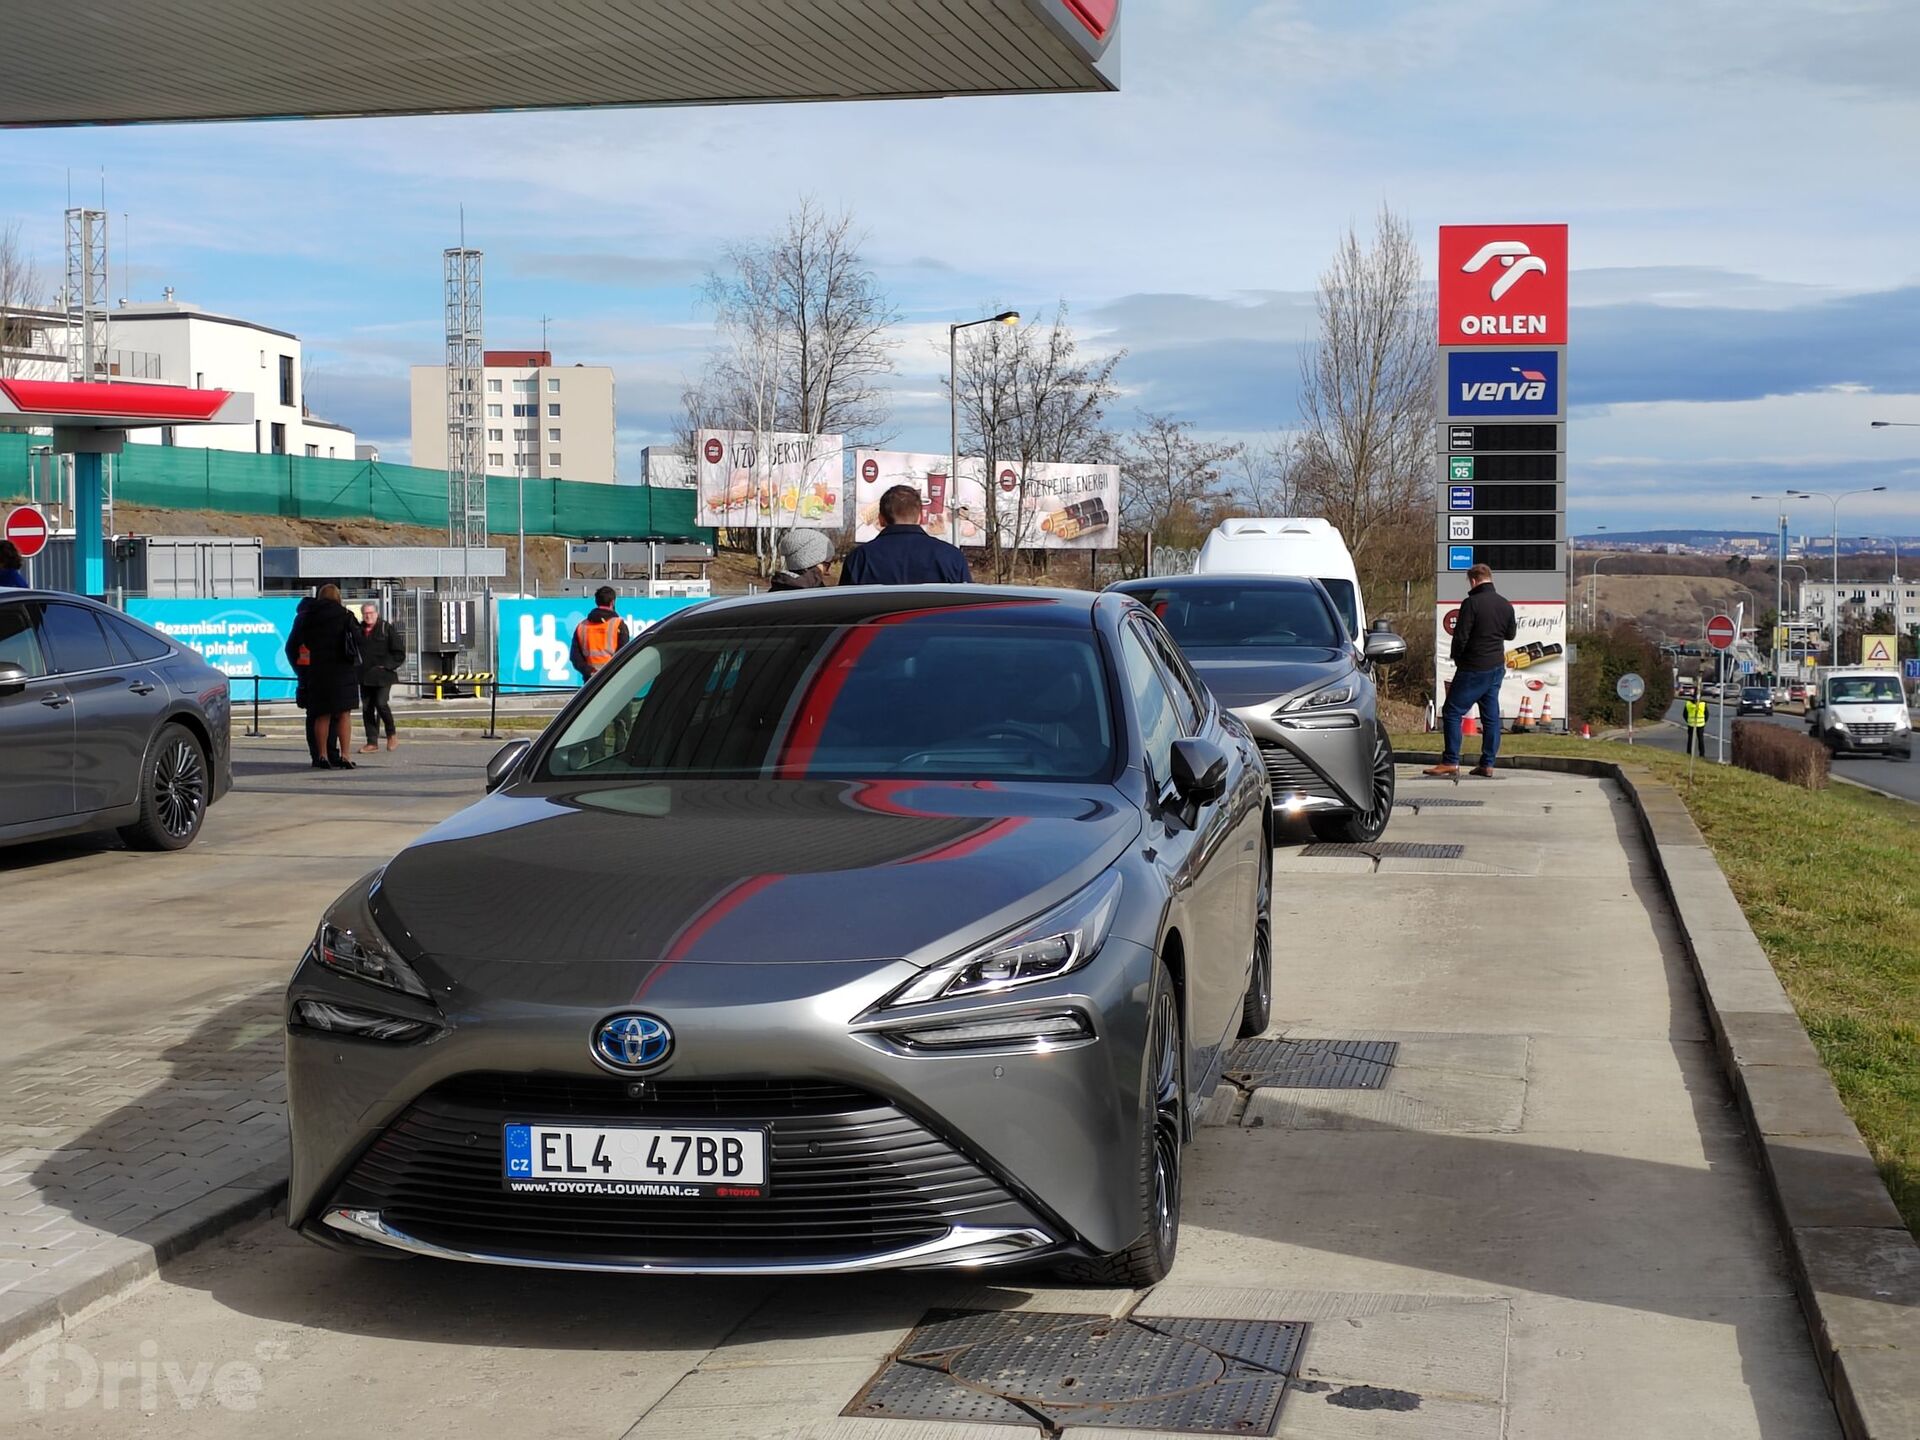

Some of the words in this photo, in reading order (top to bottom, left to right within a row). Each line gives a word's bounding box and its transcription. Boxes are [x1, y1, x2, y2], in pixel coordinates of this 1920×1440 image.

[1460, 315, 1547, 334] ORLEN
[1461, 382, 1547, 402] verva
[1455, 467, 1469, 478] 95
[1452, 526, 1470, 537] 100
[154, 620, 227, 635] Bezemisní
[228, 621, 275, 637] provoz
[205, 640, 249, 658] plnění
[540, 1132, 613, 1174] EL4
[646, 1135, 744, 1178] 47BB
[510, 1159, 529, 1172] CZ
[511, 1182, 700, 1197] www.TOYOTA-LOUWMAN.cz
[728, 1187, 761, 1198] TOYOTA
